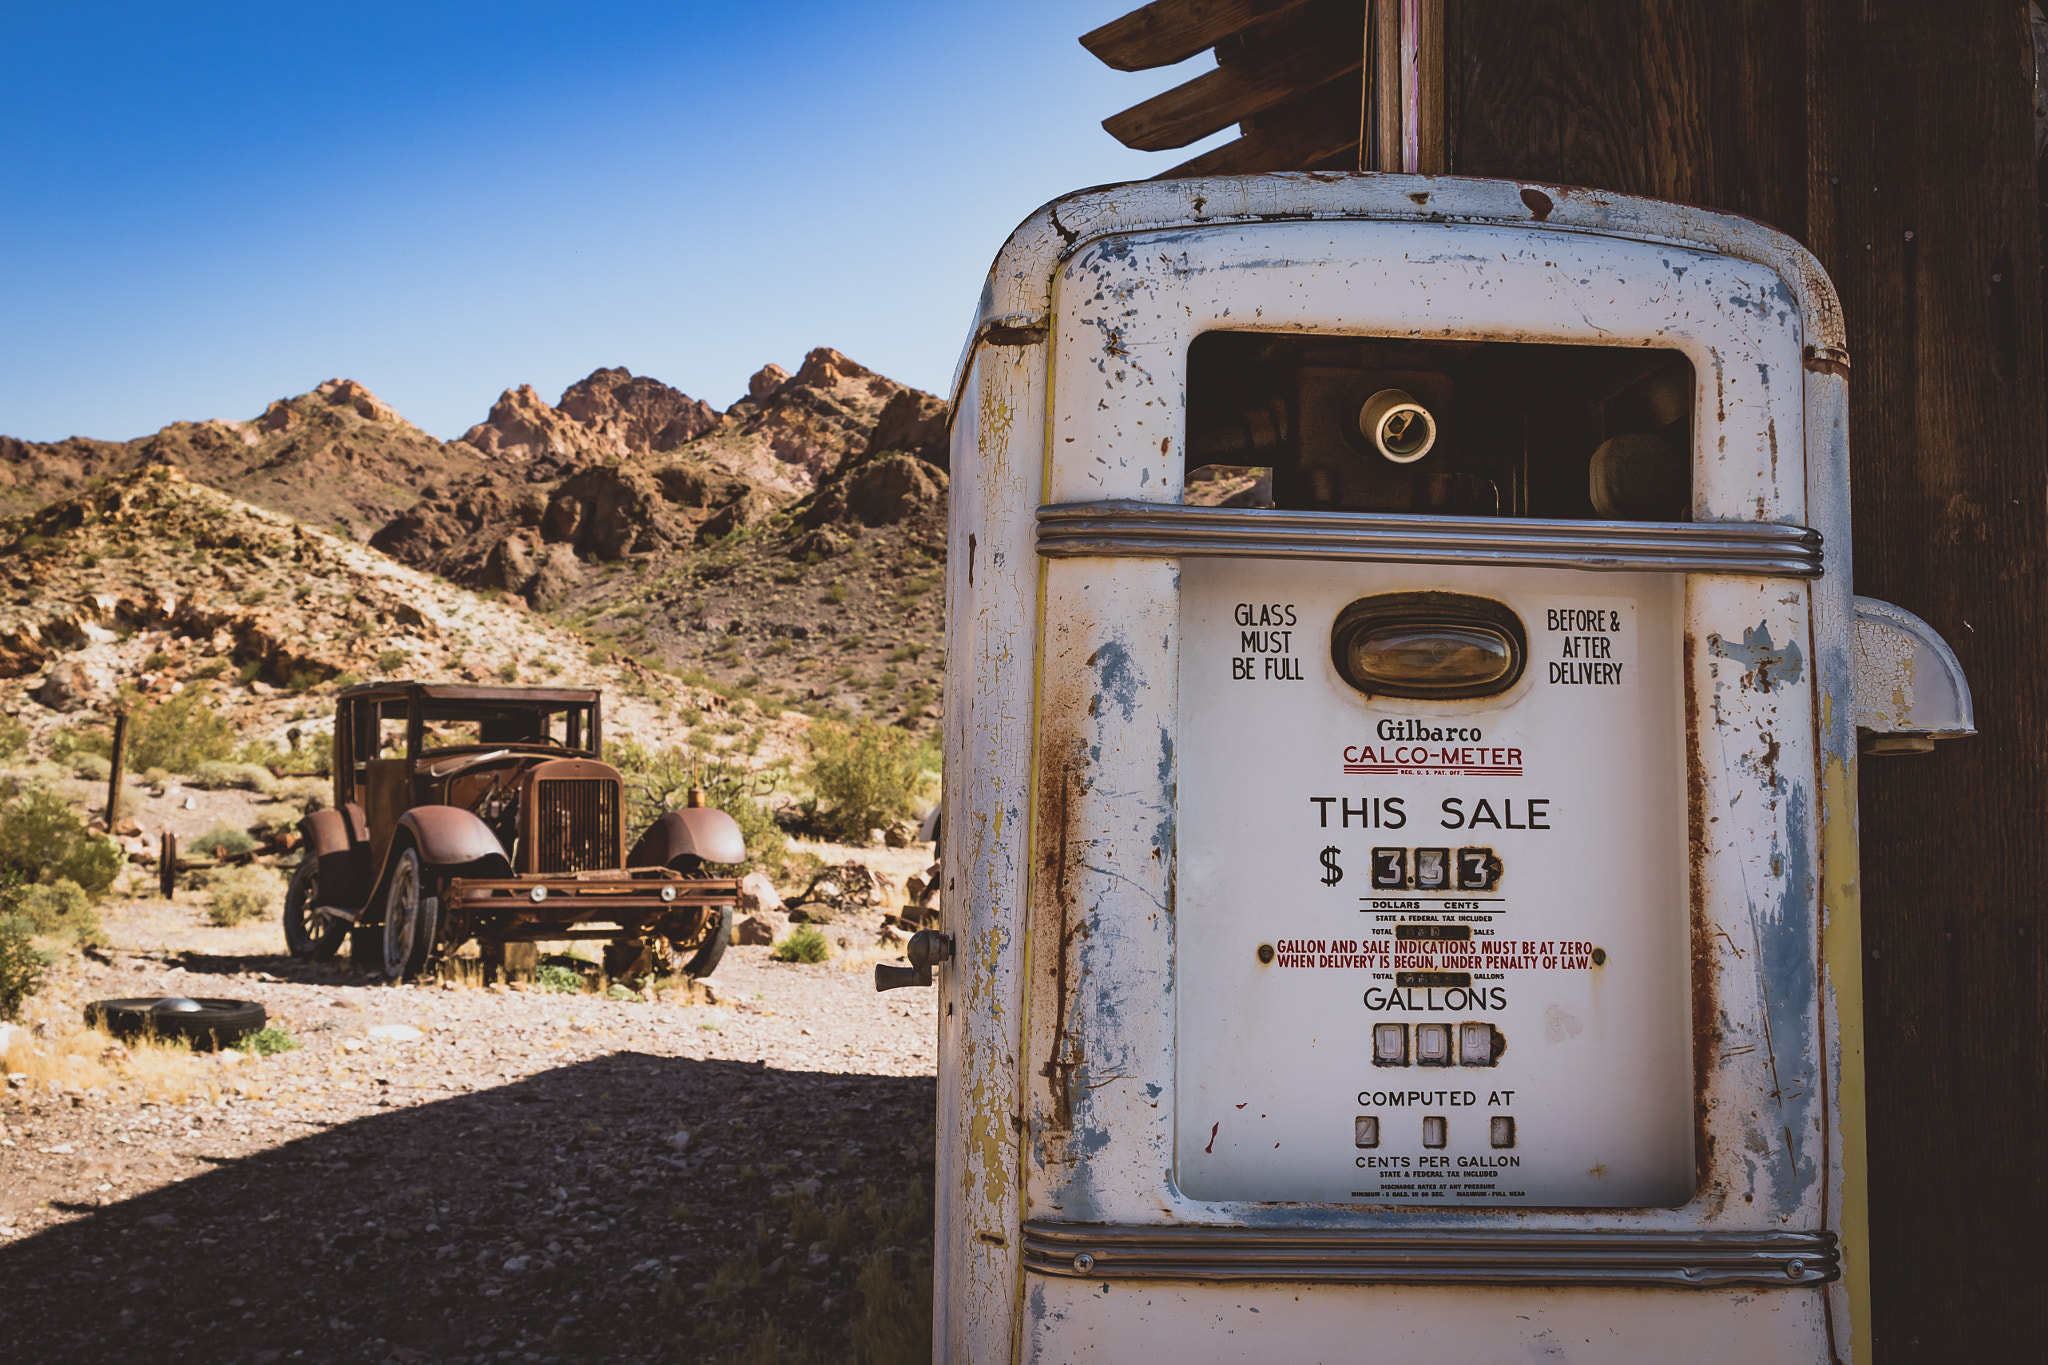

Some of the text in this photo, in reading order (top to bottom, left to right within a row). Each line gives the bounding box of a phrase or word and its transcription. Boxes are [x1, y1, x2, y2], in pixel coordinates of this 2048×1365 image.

[1234, 603, 1297, 627] GLASS
[1547, 610, 1620, 632] BEFORE &
[1242, 632, 1292, 654] MUST
[1562, 637, 1611, 659] AFTER
[1233, 658, 1304, 681] BE FULL
[1549, 661, 1623, 685] DELIVERY
[1377, 719, 1481, 742] Gilbarco
[1343, 746, 1522, 765] CALCO-METER
[1310, 797, 1551, 830] THIS SALE
[1319, 845, 1343, 887] $
[1277, 939, 1593, 955] GALLON AND SALE INDICATIONS MUST BE AT ZERO
[1277, 955, 1592, 971] WHEN DELIVERY IS BEGUN, UNDER PENALTY OF LAW.
[1364, 987, 1507, 1011] GALLONS
[1357, 1091, 1515, 1107] COMPUTED AT
[1355, 1156, 1520, 1168] CENTS PER GALLON
